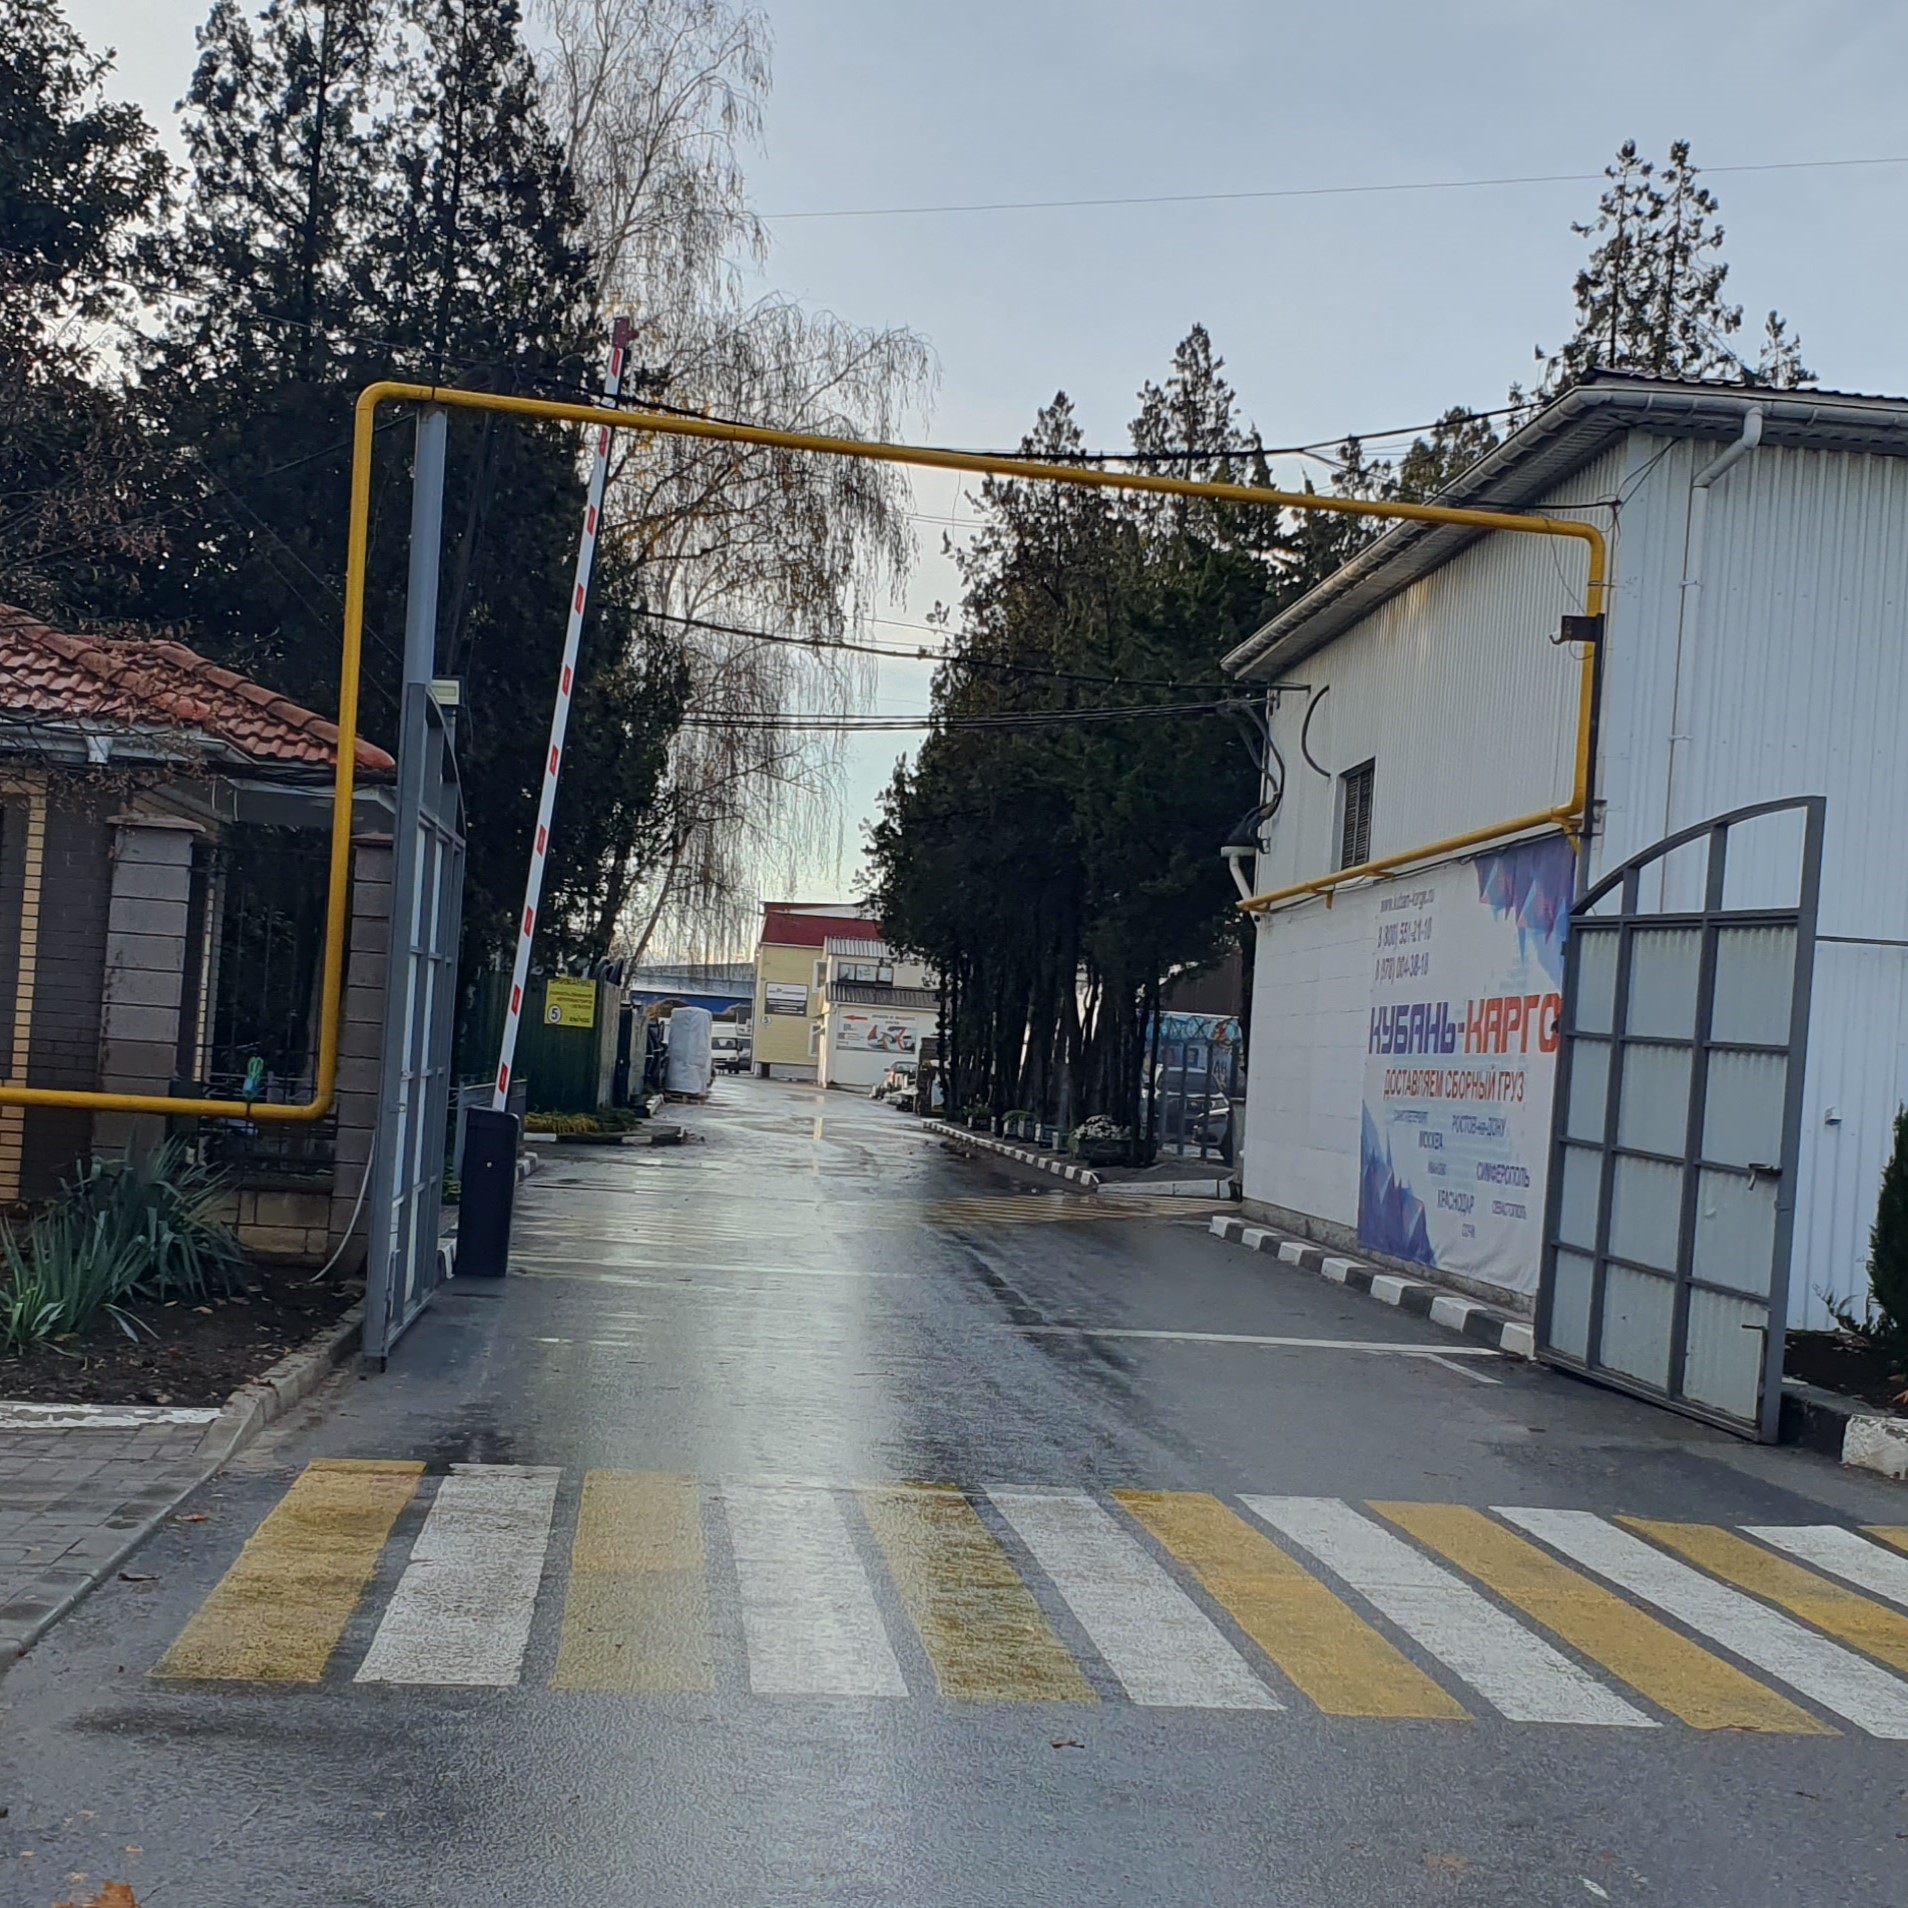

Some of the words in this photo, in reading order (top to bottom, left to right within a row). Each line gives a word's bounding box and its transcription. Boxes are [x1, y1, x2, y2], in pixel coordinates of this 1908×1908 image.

[1369, 993, 1562, 1054] КУБАНЬ-КАРГО
[1383, 1068, 1444, 1100] ДОСТАВЛЯЕМ
[1445, 1064, 1496, 1101] СБОРНЫЙ
[1498, 1071, 1525, 1102] ГРУЗ
[1476, 1161, 1530, 1188] СИМФЕРОПОЛЬ
[1437, 1190, 1475, 1216] КРАСНОДАР
